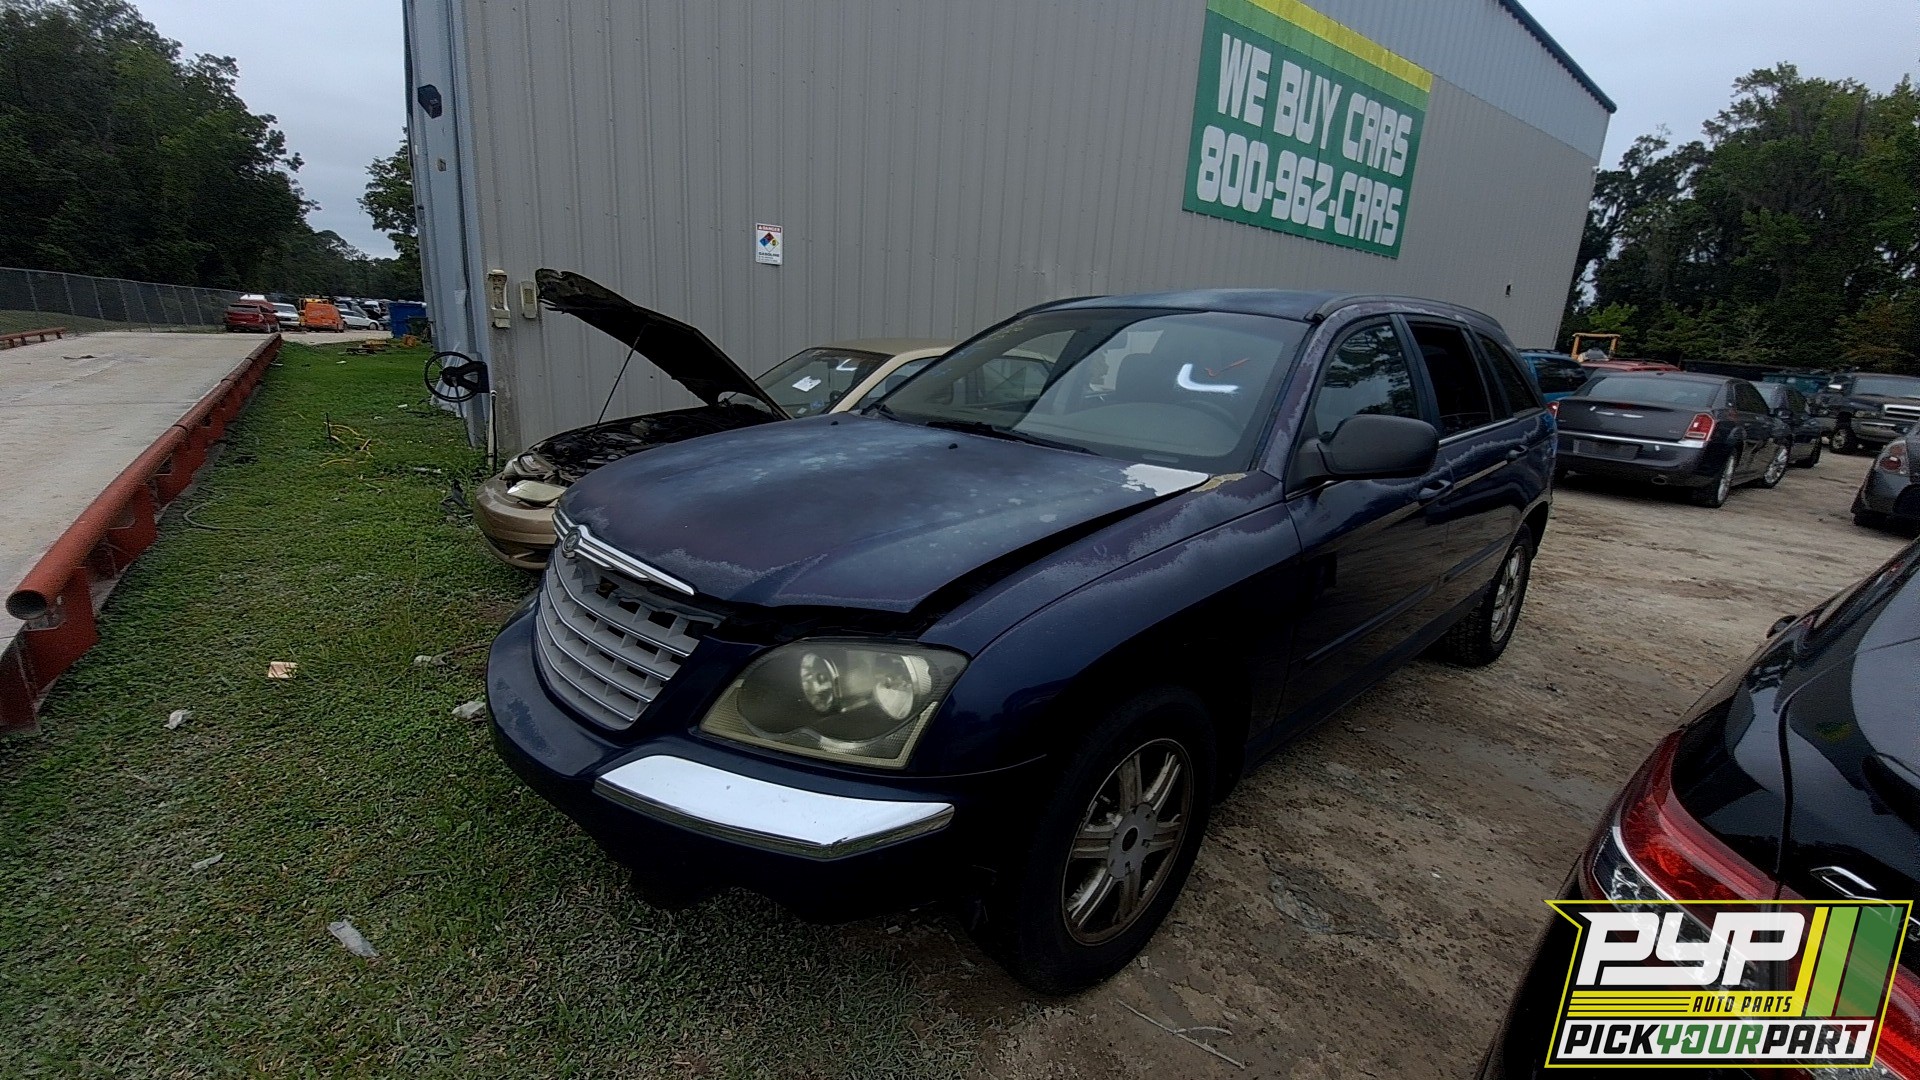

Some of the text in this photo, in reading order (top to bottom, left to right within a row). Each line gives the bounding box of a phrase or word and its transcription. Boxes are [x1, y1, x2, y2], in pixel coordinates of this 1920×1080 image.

[1217, 33, 1413, 177] WE BUY CARS
[1197, 125, 1403, 246] 800-962-CARS
